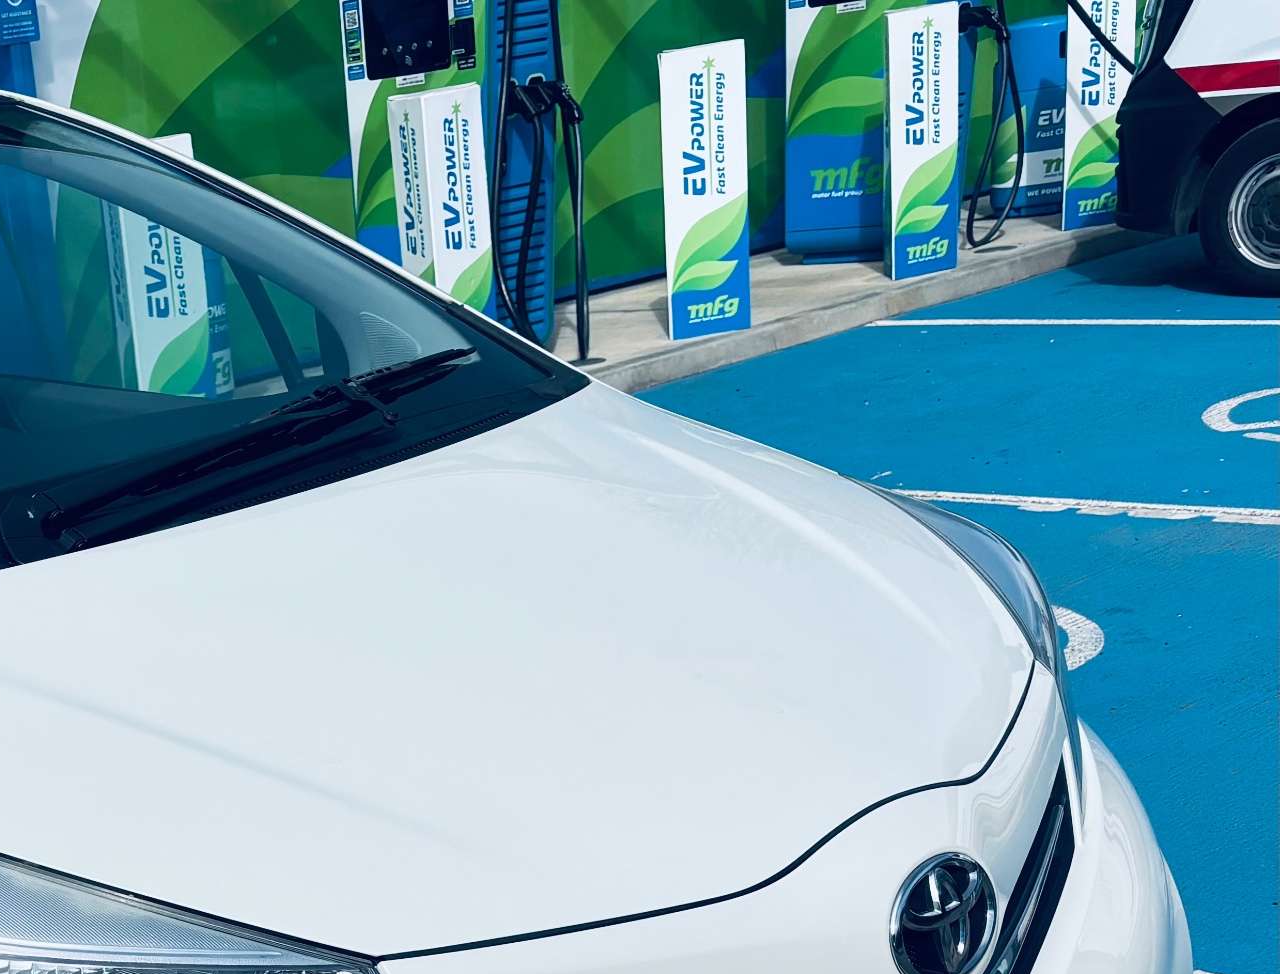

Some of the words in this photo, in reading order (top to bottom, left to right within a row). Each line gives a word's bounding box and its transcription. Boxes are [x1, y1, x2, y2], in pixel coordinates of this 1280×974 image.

[931, 31, 942, 76] Energy
[714, 72, 726, 120] Energy
[931, 77, 941, 115] Clean
[1107, 81, 1116, 105] Fast
[461, 119, 471, 169] Energy
[715, 125, 725, 163] Clean
[932, 118, 940, 144] Fast
[464, 175, 475, 215] Clean
[716, 167, 726, 194] Fast
[810, 157, 883, 195] mfg
[174, 235, 185, 280] Clean
[906, 236, 949, 259] mfg
[178, 282, 188, 316] Fast
[687, 294, 740, 318] mfg
